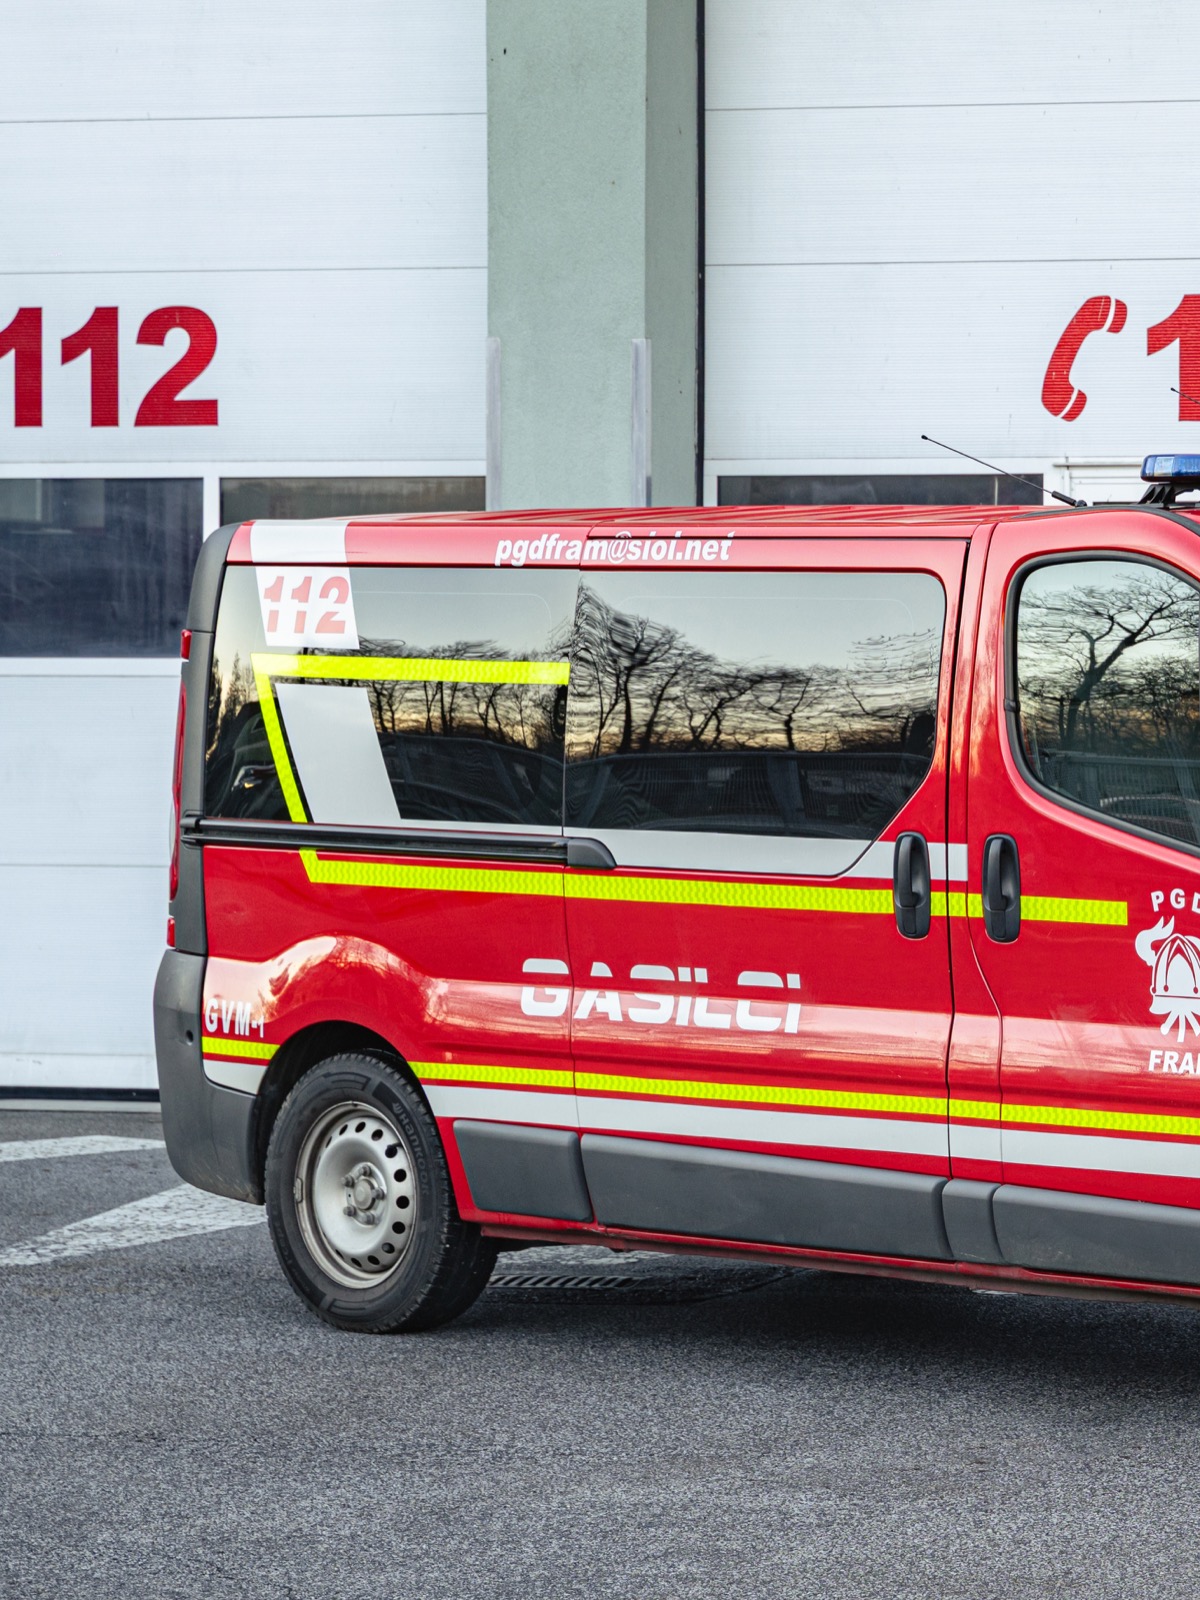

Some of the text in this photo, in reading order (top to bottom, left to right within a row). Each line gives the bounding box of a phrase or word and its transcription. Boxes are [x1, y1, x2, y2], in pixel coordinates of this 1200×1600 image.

[0, 305, 218, 427] 112
[494, 531, 736, 566] pgdfram@siol.net
[263, 575, 350, 635] 112
[204, 998, 265, 1039] GVM-1
[520, 957, 801, 1034] GASILCI
